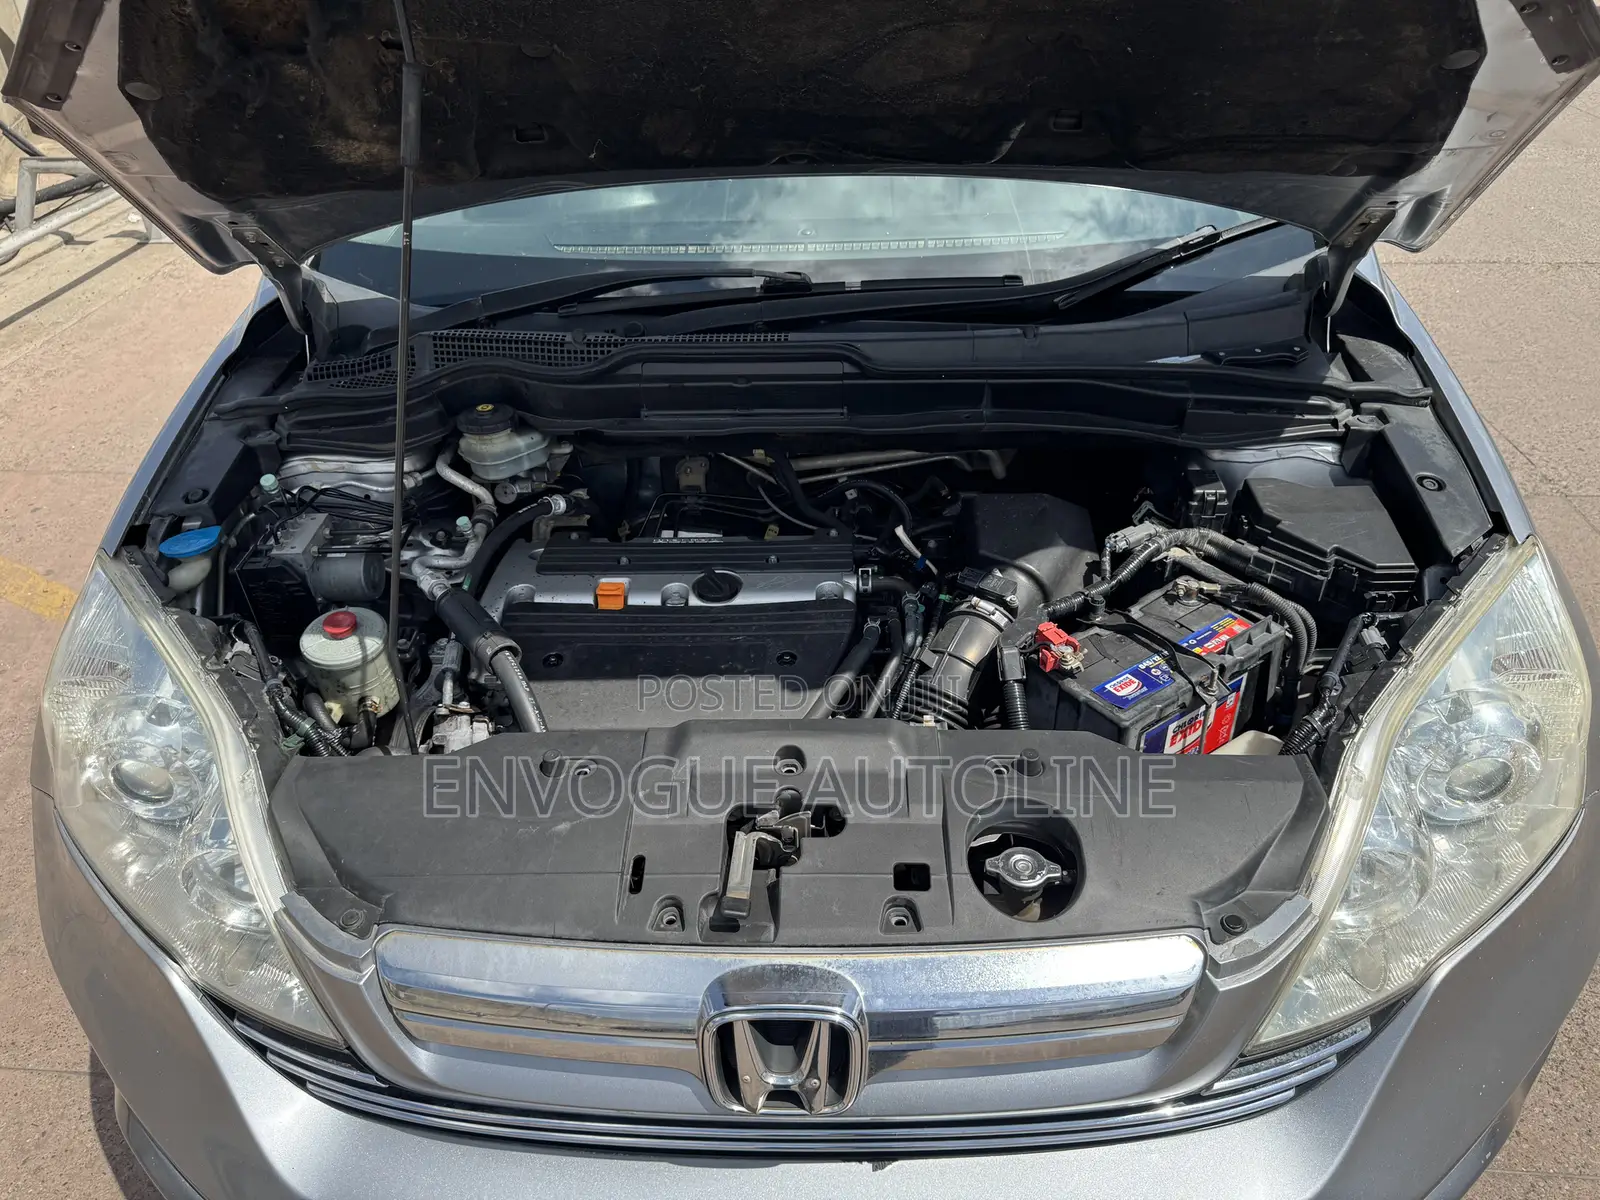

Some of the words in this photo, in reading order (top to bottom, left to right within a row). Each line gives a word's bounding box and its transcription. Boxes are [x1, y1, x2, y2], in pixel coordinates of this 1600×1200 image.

[1112, 678, 1137, 693] EXIDE
[1169, 719, 1204, 748] EXID
[1172, 710, 1206, 734] CHLORI
